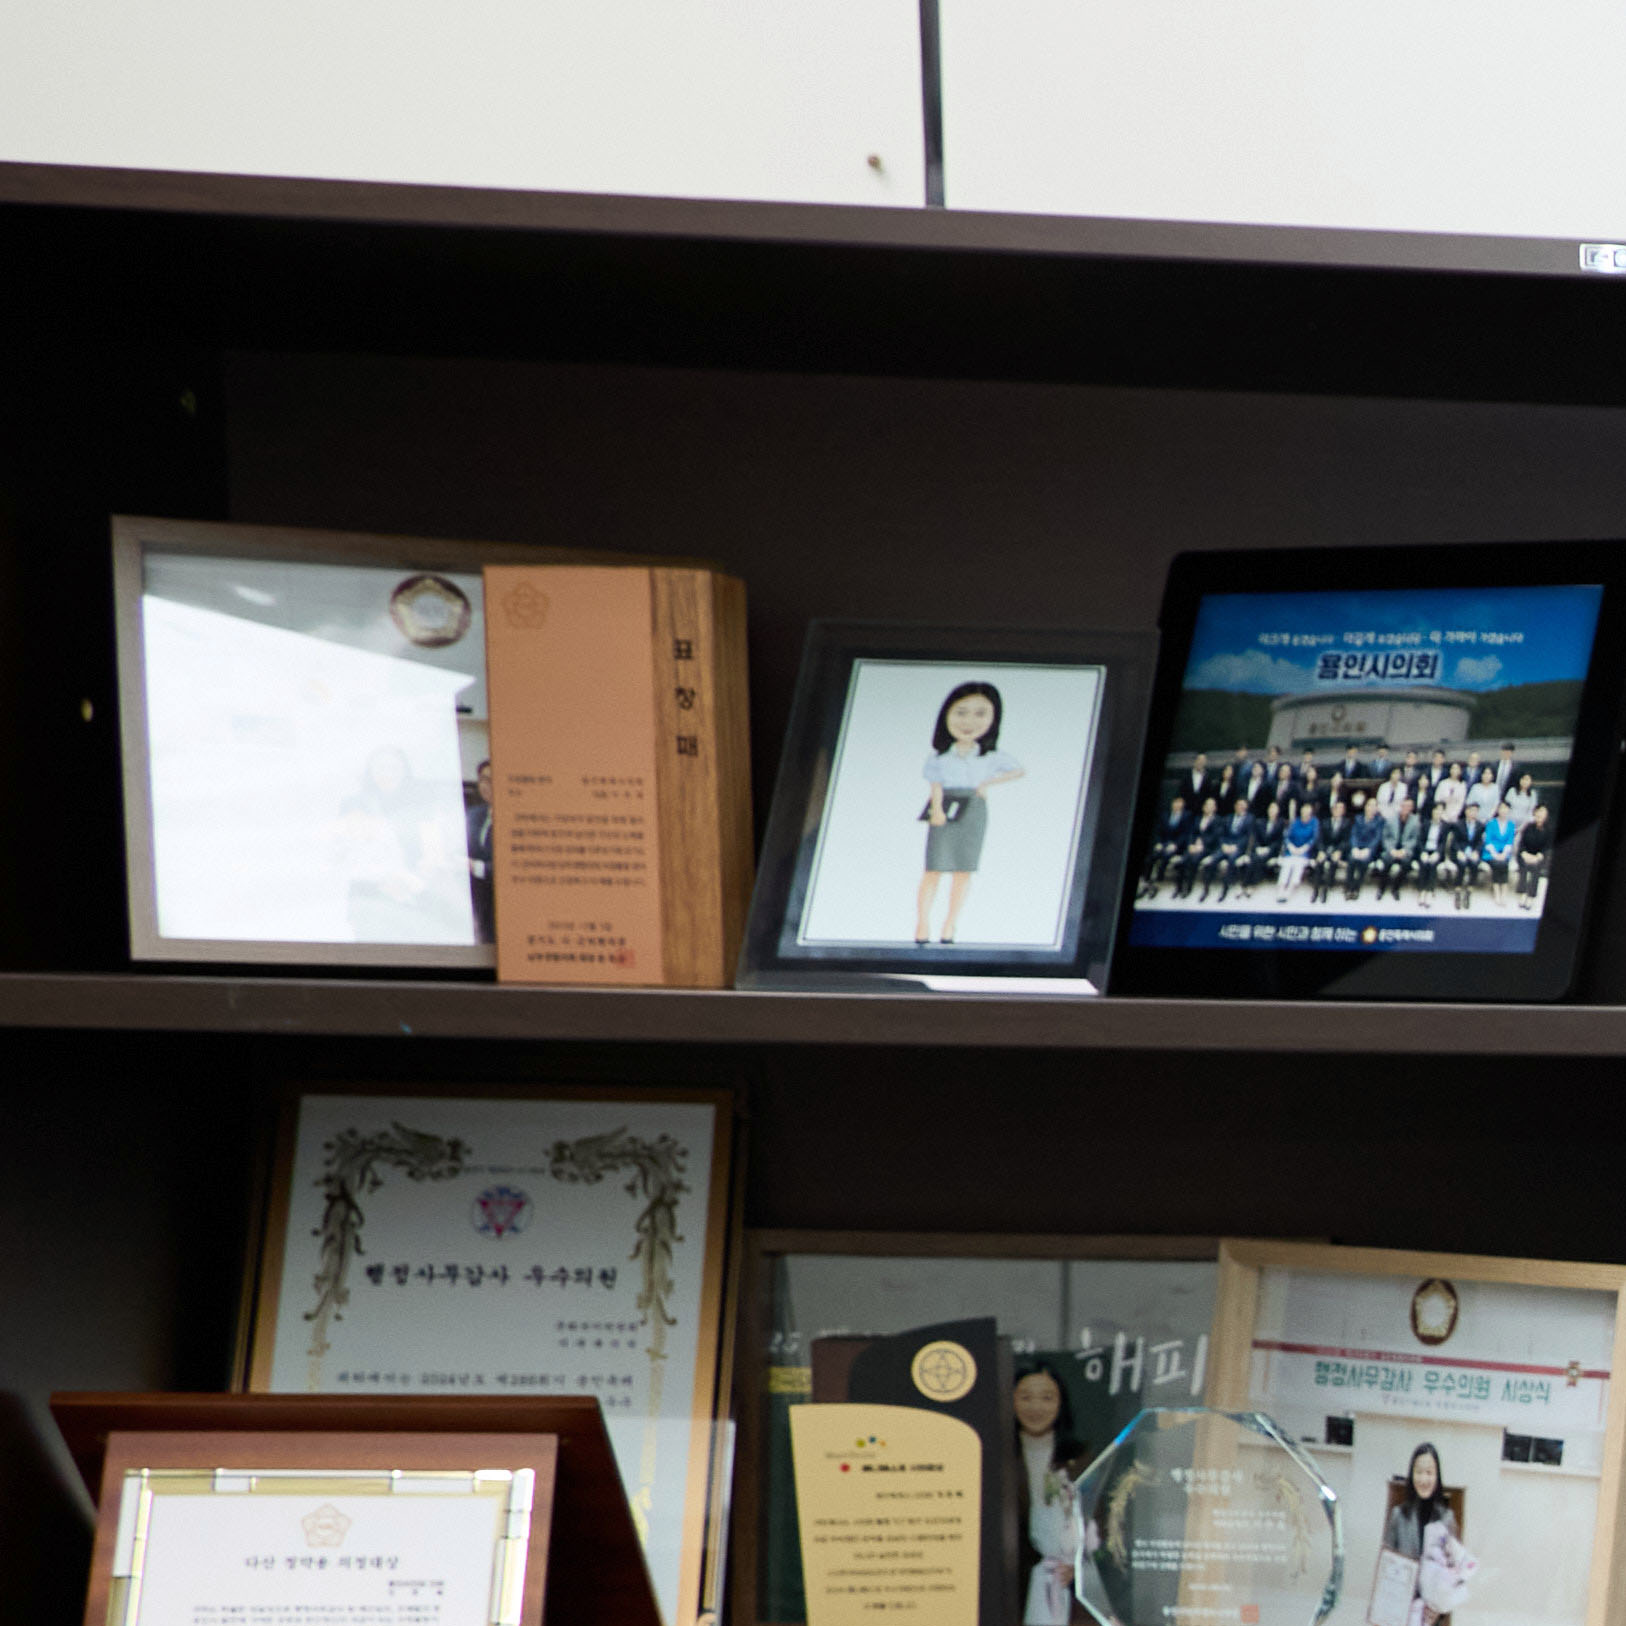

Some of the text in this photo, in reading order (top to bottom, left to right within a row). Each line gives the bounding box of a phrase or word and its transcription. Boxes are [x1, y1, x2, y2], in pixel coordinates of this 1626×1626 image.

[1317, 652, 1440, 680] 용인시의회
[1313, 1360, 1552, 1405] 행정사무감사 우수의원 시상식
